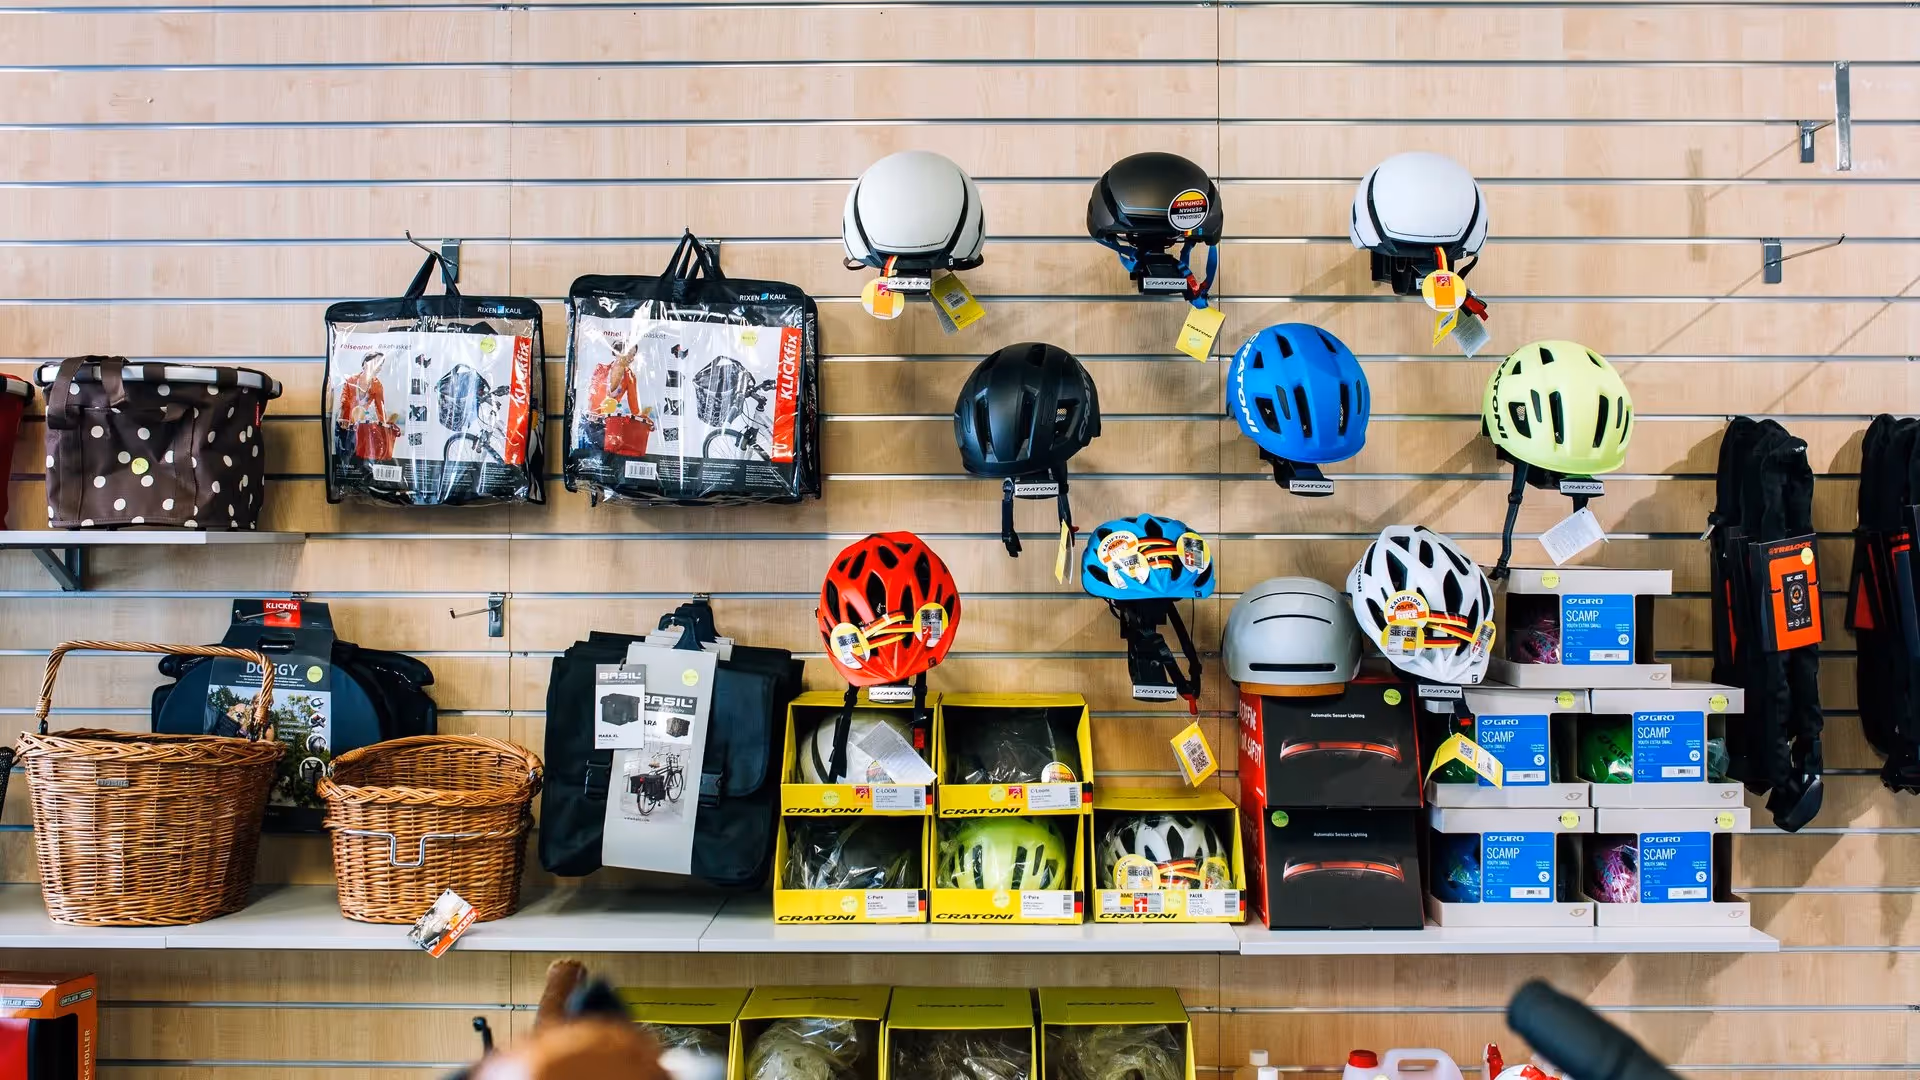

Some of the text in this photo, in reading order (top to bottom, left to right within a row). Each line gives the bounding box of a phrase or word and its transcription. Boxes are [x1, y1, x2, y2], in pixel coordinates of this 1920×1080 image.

[1176, 199, 1204, 207] COMPANY
[1178, 206, 1203, 214] GERMAN
[1176, 213, 1202, 221] ORIGINAL
[477, 306, 497, 314] RIXEN
[780, 334, 798, 400] KLICKfix
[1236, 332, 1261, 433] CRATONI
[1773, 541, 1812, 554] TRELOCK
[1389, 596, 1421, 610] KAUFTIPP
[1566, 610, 1600, 622] SCAMP
[1390, 629, 1417, 638] SIEGER
[599, 672, 642, 680] BASIL
[1482, 731, 1515, 743] SCAMP
[1637, 727, 1671, 739] SCAMP
[1487, 847, 1520, 859] SCAMP
[1643, 848, 1677, 860] SCAMP
